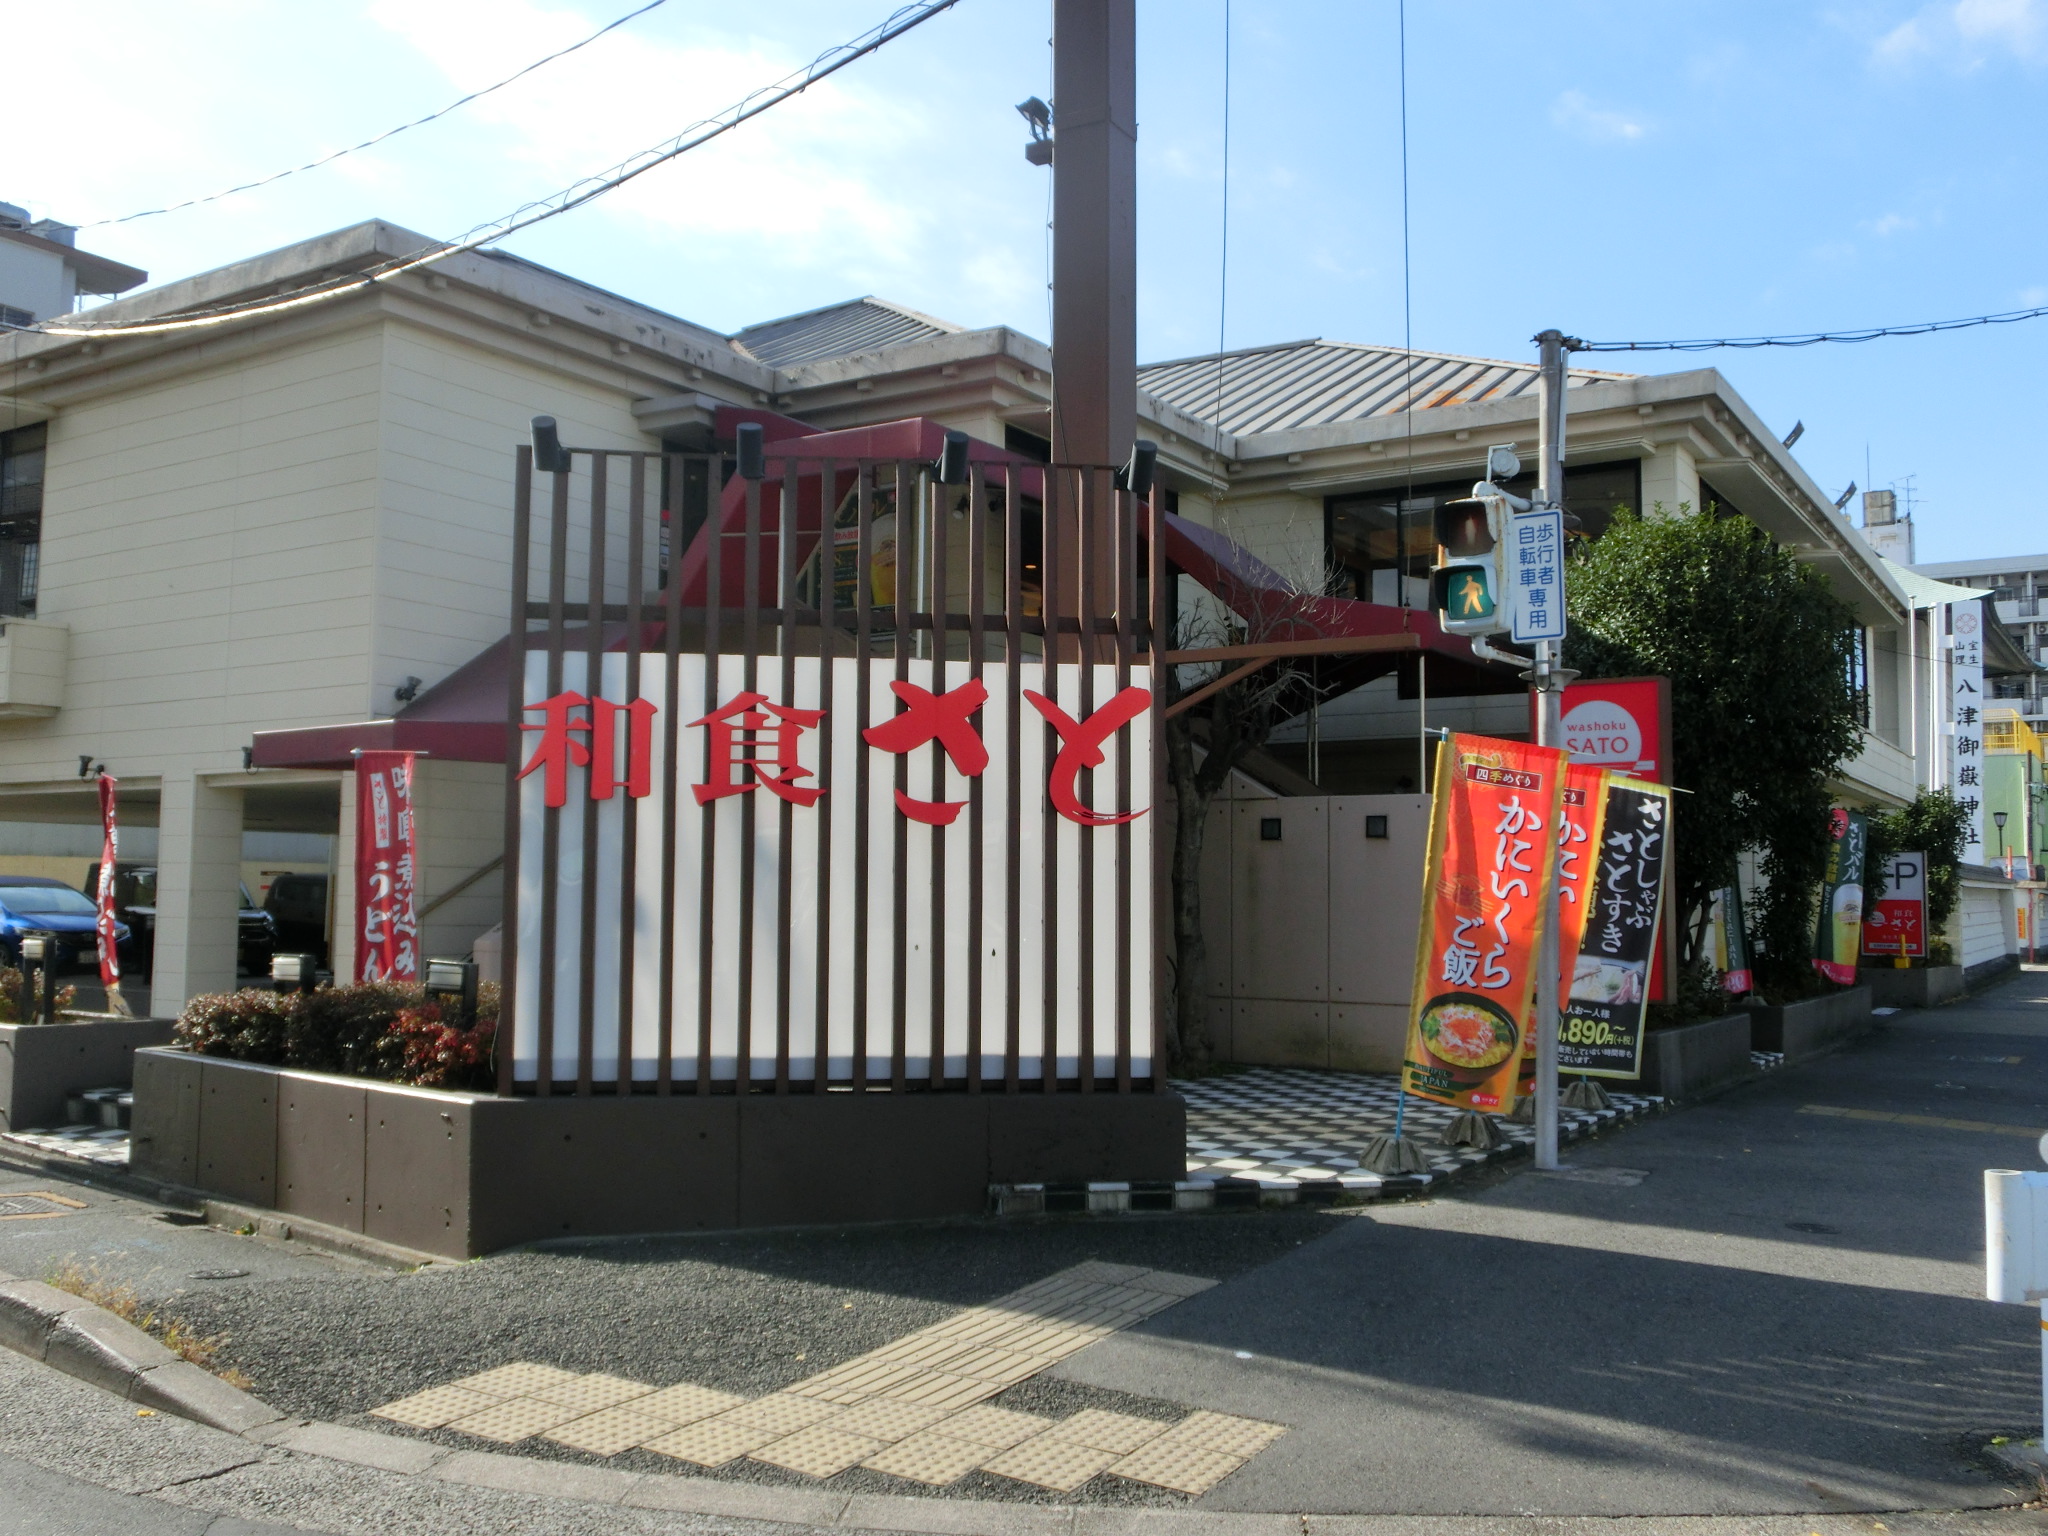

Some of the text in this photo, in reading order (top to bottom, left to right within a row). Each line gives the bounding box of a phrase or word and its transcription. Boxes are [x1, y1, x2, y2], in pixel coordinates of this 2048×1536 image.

[1519, 526, 1536, 587] 自転車
[1537, 524, 1554, 585] 歩行者
[1528, 589, 1547, 629] 専用
[1567, 720, 1627, 731] washoku
[1567, 736, 1629, 755] SATO
[1476, 768, 1531, 787] 四季めぐり
[1481, 795, 1542, 990] かにいくら
[1601, 830, 1634, 953] さとすき
[1625, 797, 1663, 929] さとしゃぶ
[1895, 862, 1918, 890] P
[362, 860, 394, 983] うどん
[1442, 914, 1486, 989] ご飯
[1420, 1075, 1449, 1088] JAPAN
